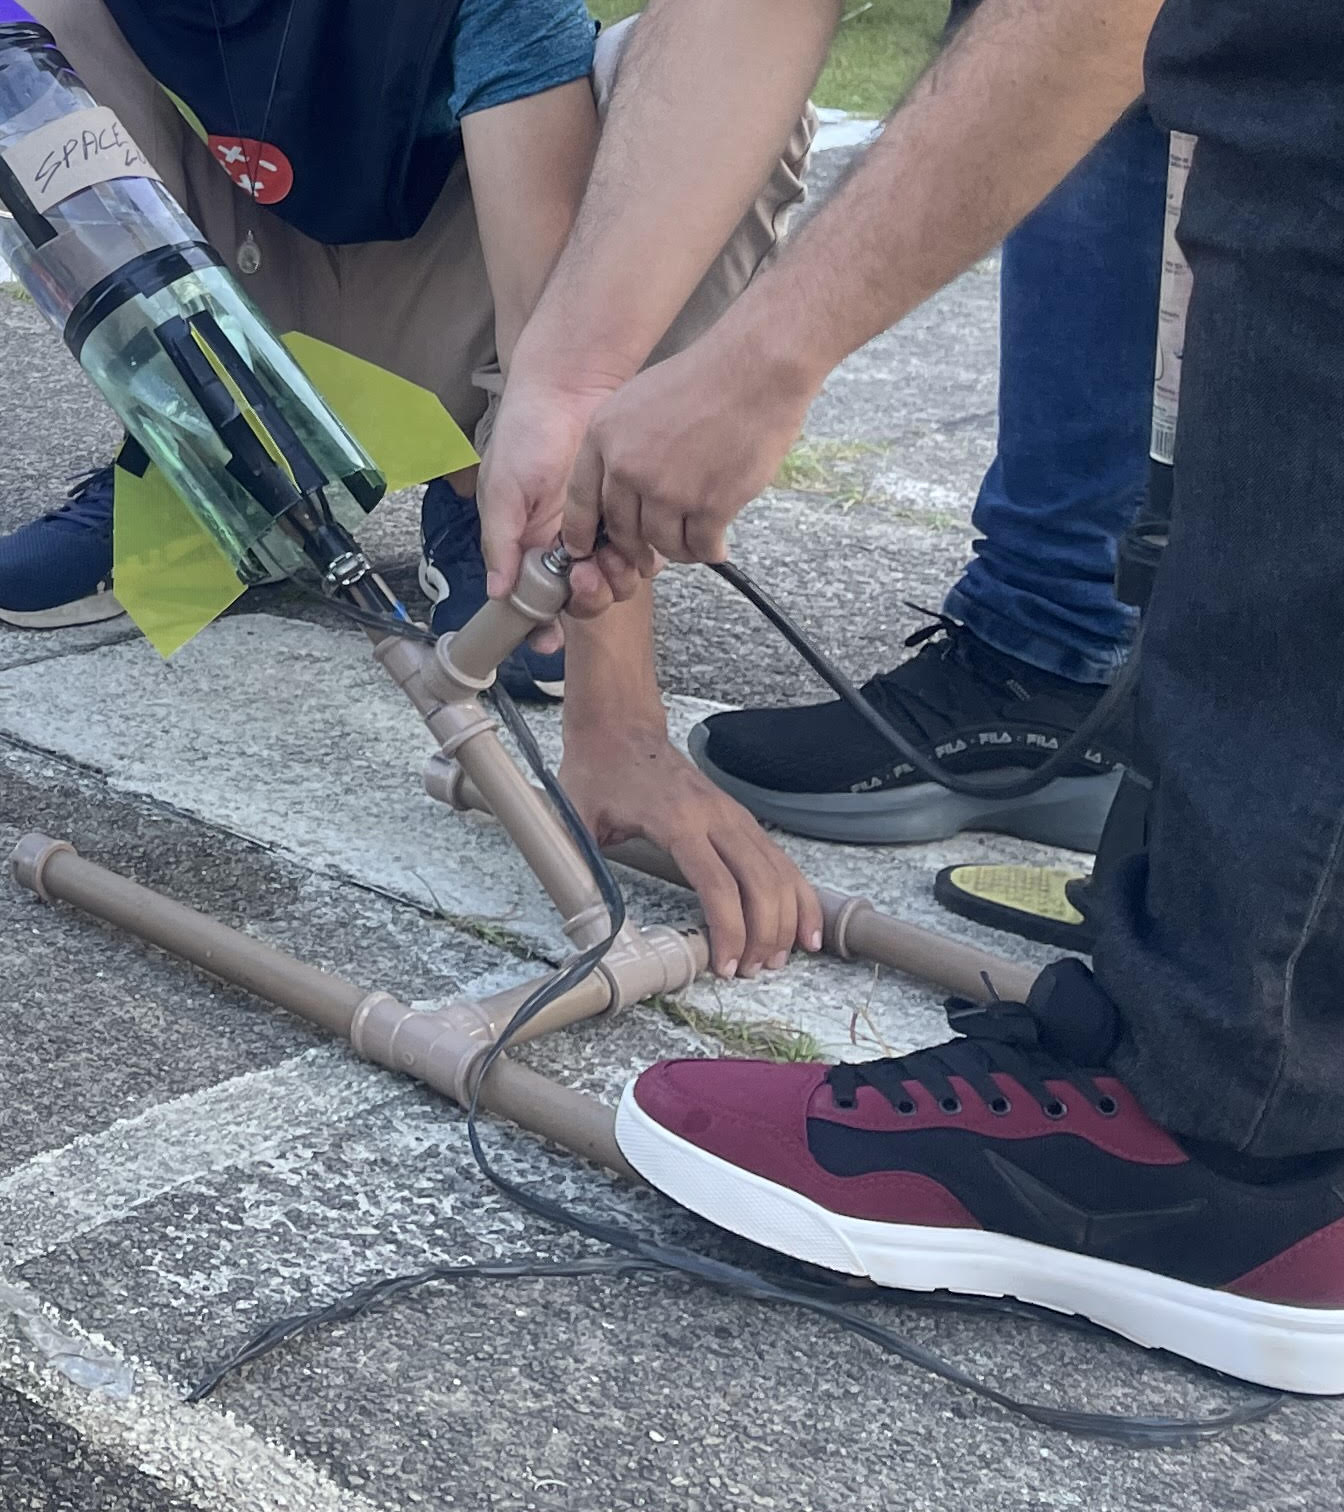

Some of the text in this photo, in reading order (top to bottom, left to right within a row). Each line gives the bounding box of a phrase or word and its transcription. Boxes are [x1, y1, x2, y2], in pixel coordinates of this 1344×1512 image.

[34, 122, 128, 194] SPACE
[850, 776, 883, 794] FILA
[935, 739, 967, 759] FILA
[979, 731, 1012, 745] FILA
[1027, 734, 1059, 749] FILA
